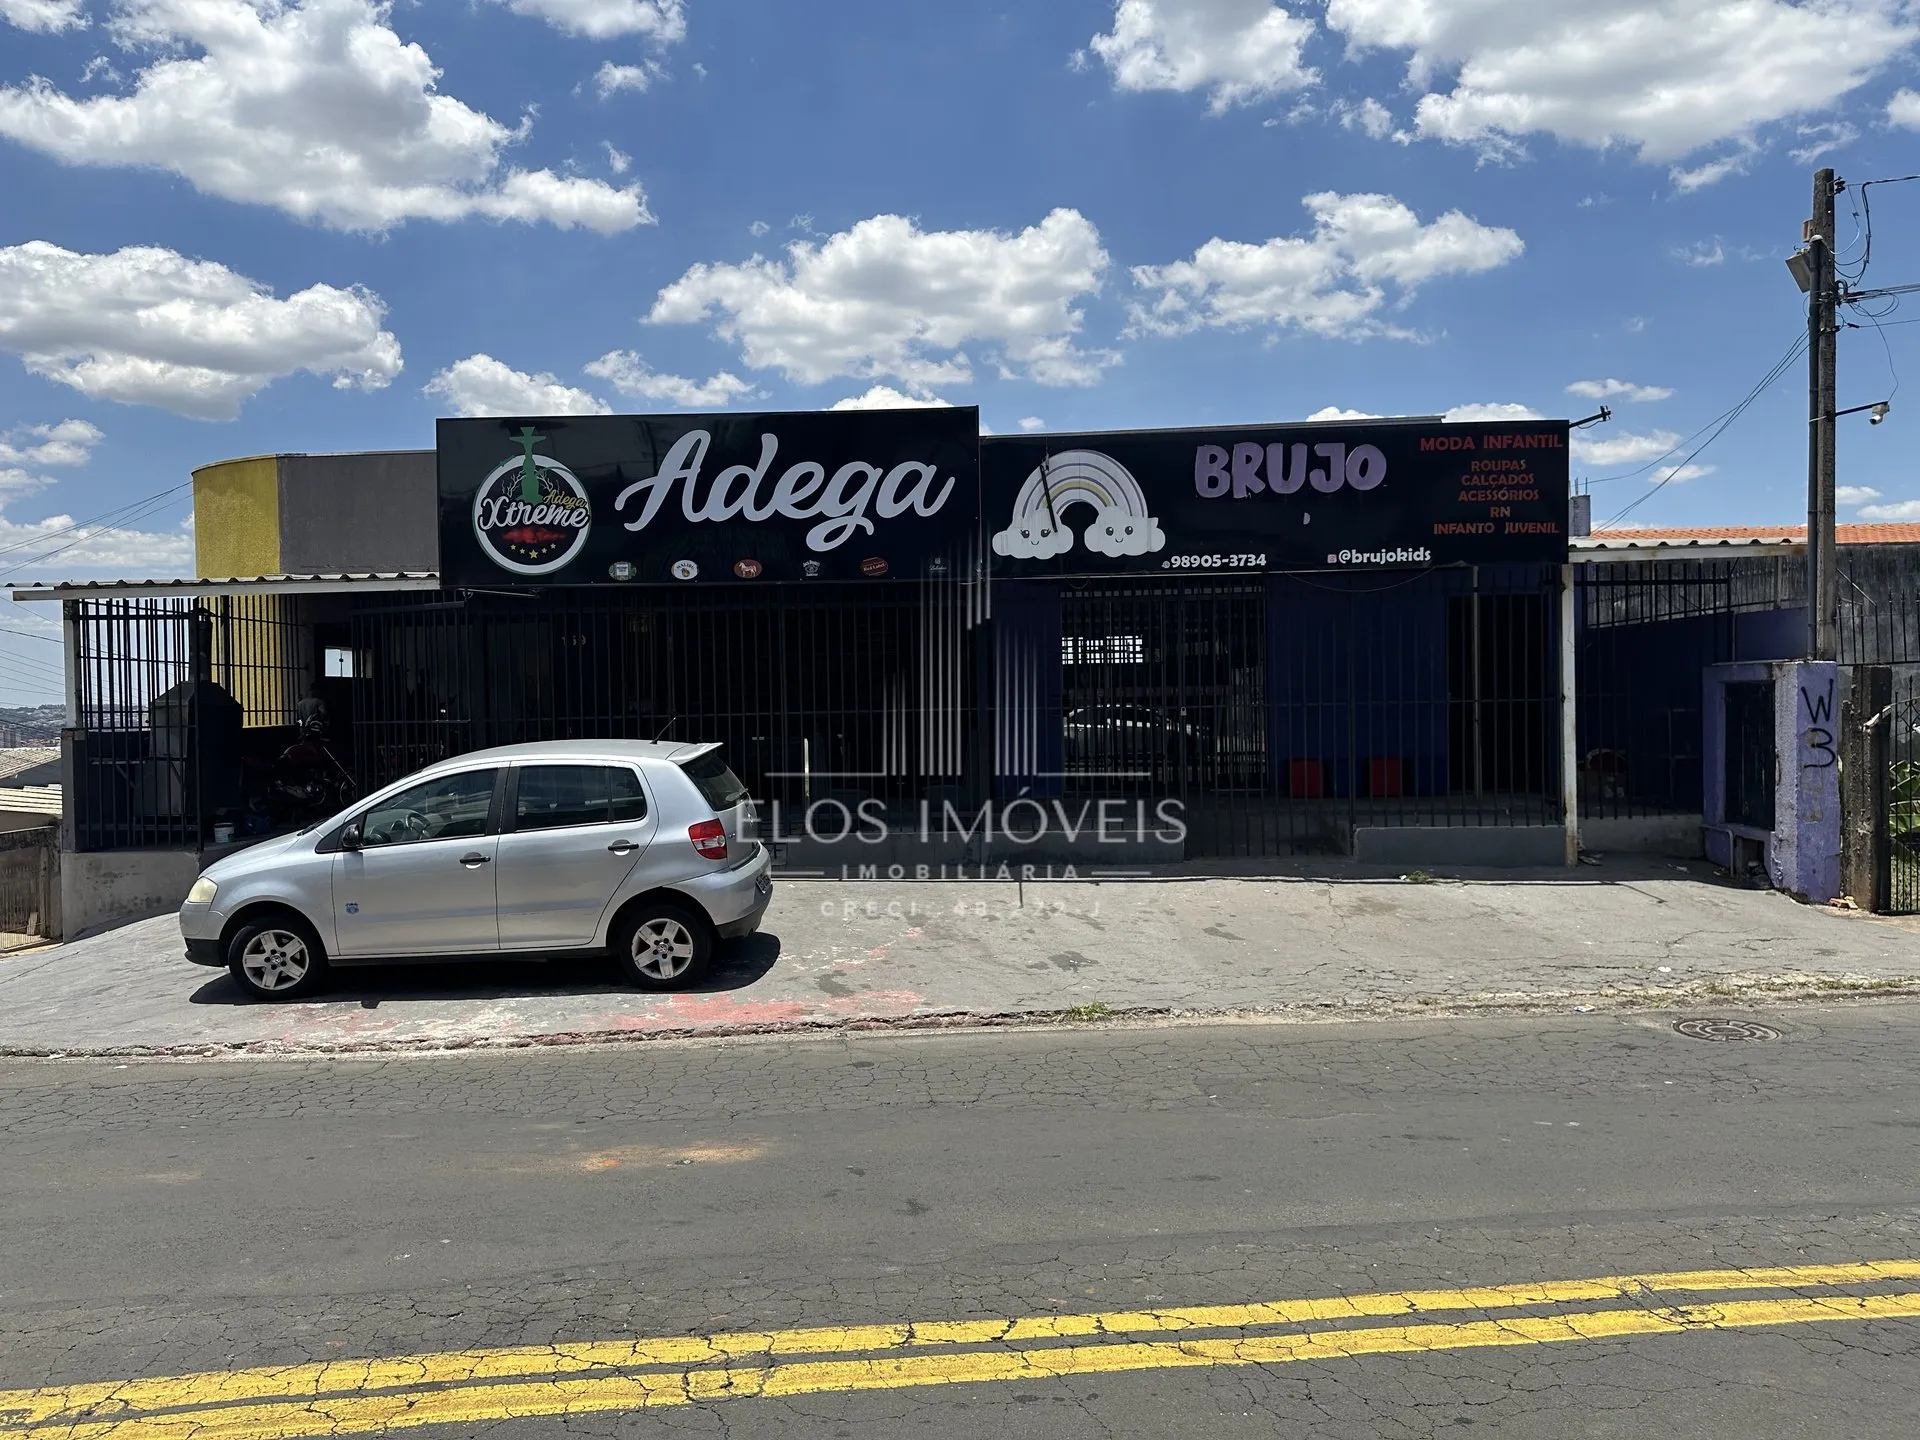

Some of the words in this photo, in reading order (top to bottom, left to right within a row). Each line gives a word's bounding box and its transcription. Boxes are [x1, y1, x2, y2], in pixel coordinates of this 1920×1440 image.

[1420, 436, 1475, 451] MODA
[1483, 434, 1563, 449] INFANTIL
[1194, 441, 1387, 499] BRUJO
[1471, 459, 1526, 472] ROUPAS
[1461, 473, 1534, 488] CALÇADOS
[615, 429, 956, 552] Adega
[1458, 487, 1540, 502] ACESSÓRIOS
[543, 489, 586, 509] Adega
[480, 496, 589, 530] Xtreme
[1490, 506, 1511, 518] RN
[1433, 523, 1495, 535] INFANTO
[1504, 522, 1559, 534] JUVENIL
[1170, 553, 1267, 568] 98905-3734
[1338, 547, 1431, 564] @brujokids
